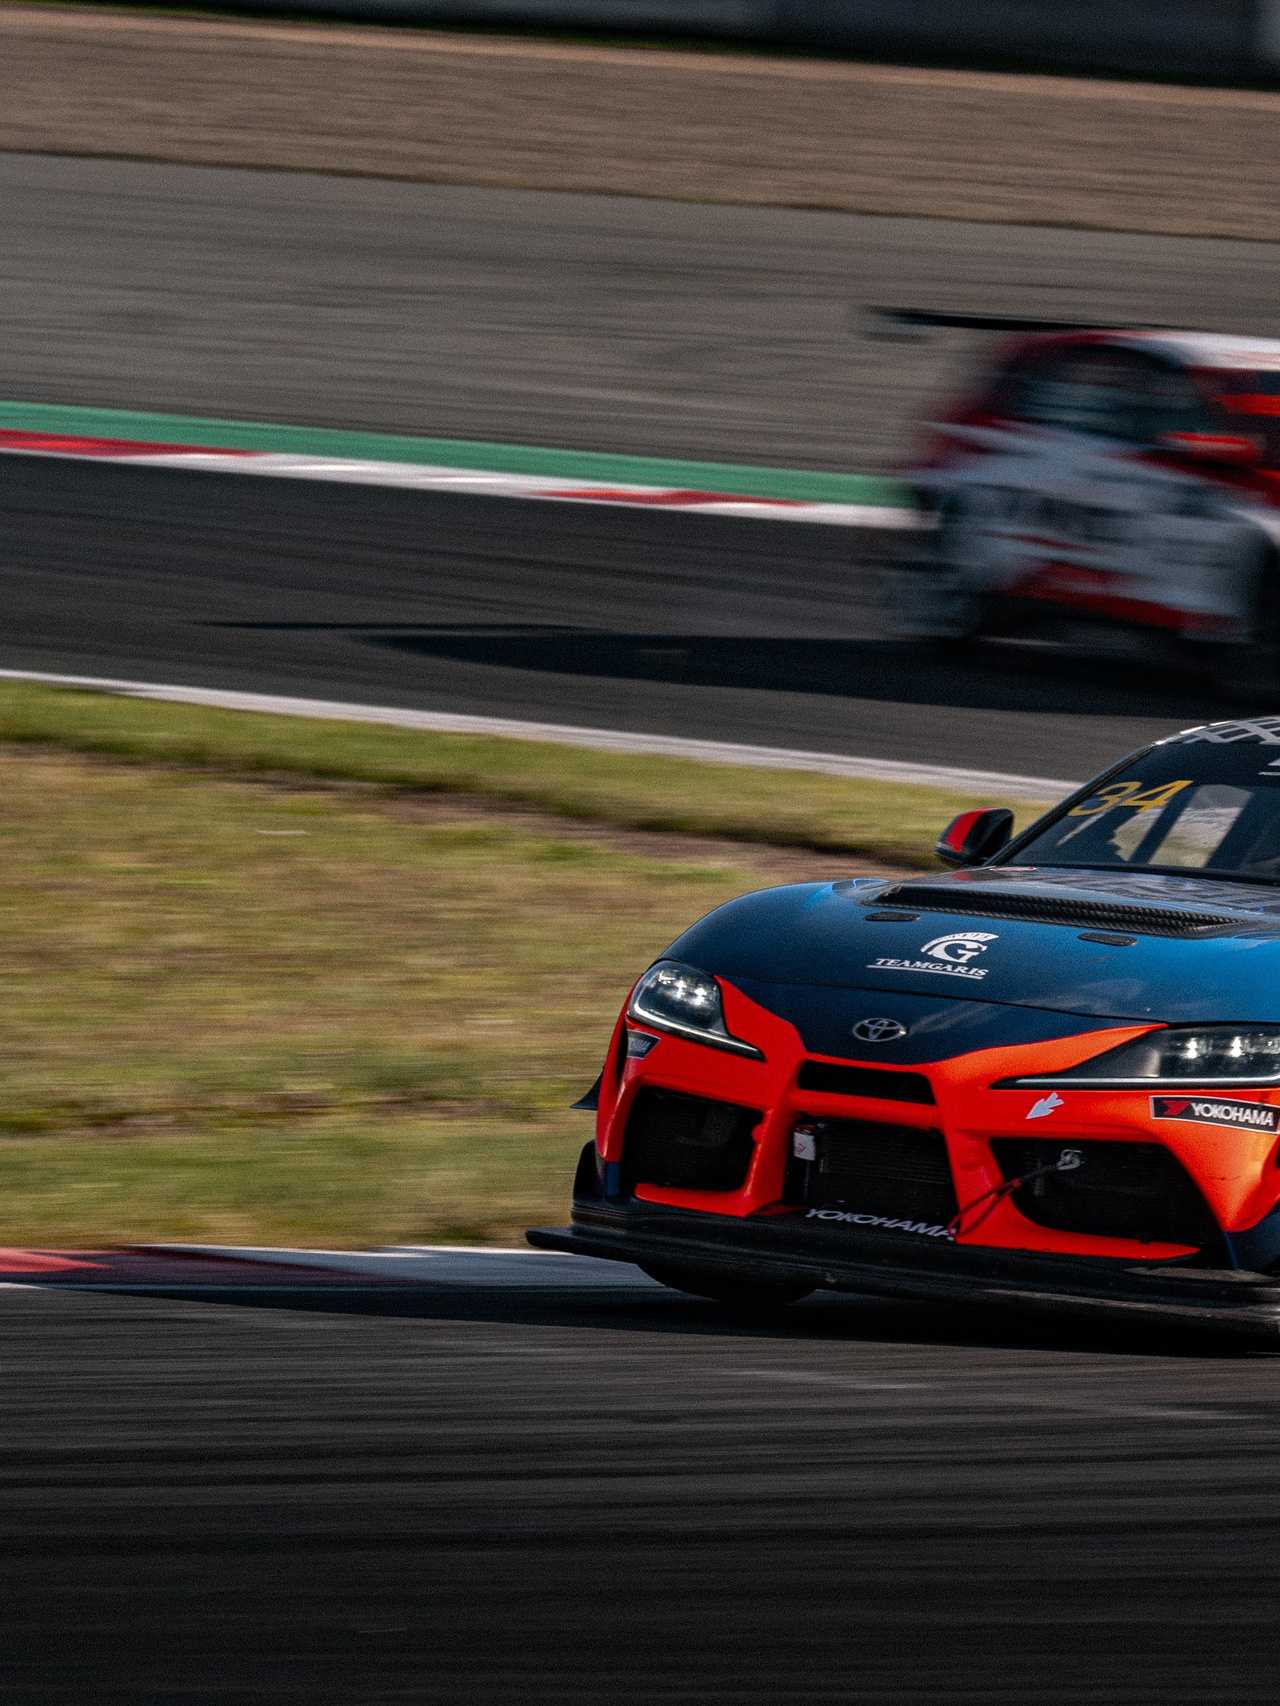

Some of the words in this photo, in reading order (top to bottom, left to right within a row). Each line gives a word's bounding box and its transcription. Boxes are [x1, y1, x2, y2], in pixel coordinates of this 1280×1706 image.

[1067, 780, 1194, 817] 34
[875, 958, 990, 976] TEAMGARIS
[1190, 1102, 1274, 1127] YOKOHAMA
